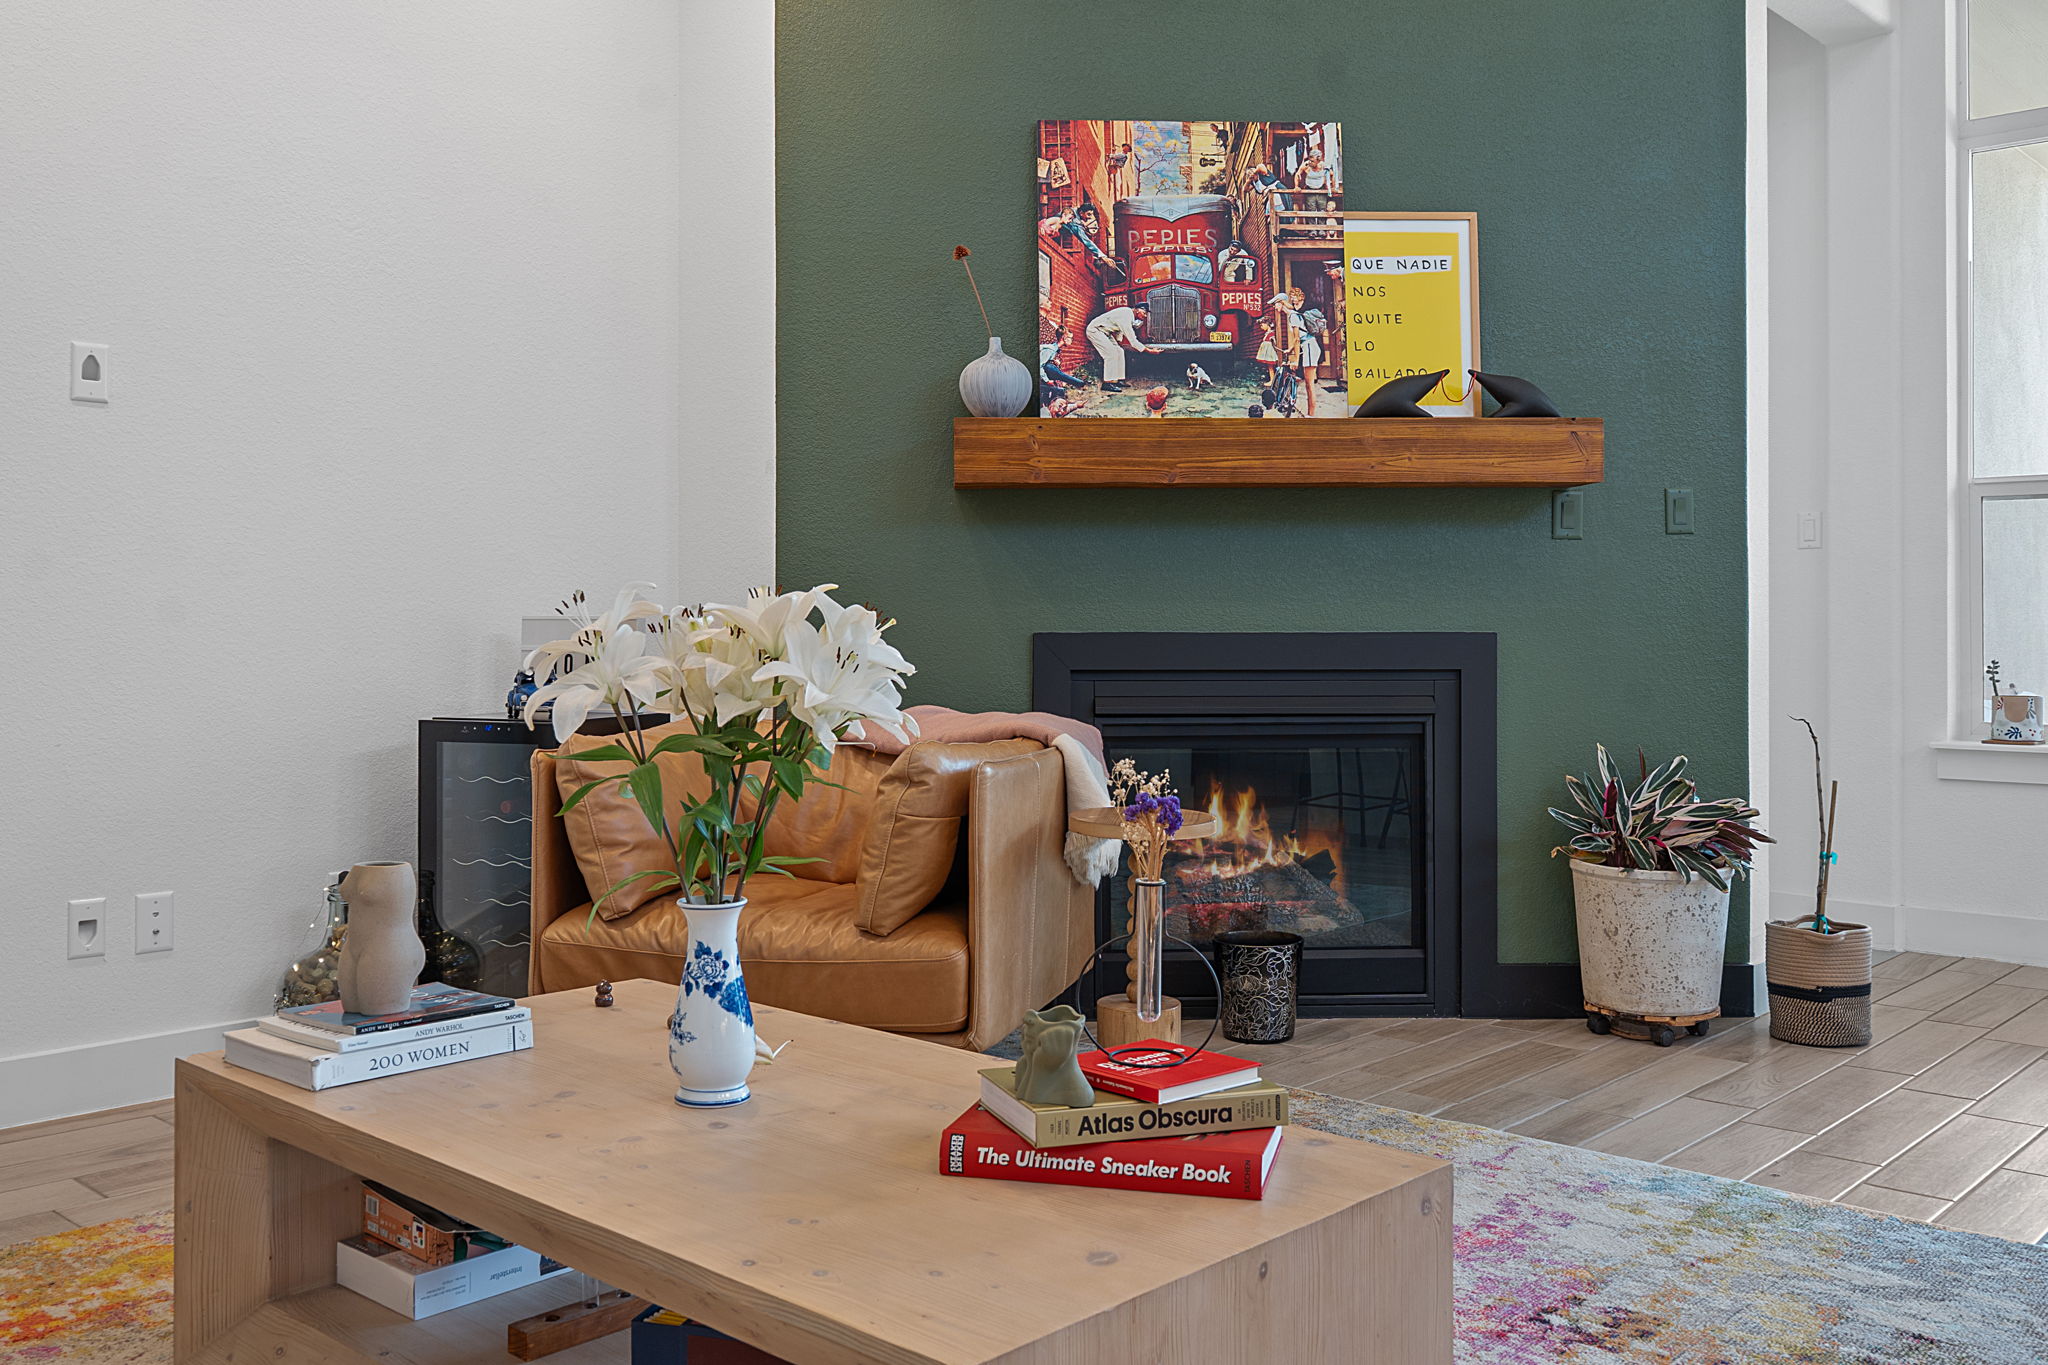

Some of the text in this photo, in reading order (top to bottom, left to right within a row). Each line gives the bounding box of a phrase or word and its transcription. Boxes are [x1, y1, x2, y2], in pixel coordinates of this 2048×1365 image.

[1128, 229, 1217, 249] PEPIES
[1140, 245, 1208, 253] PEPIES
[1352, 258, 1449, 270] QUE NADIE
[1221, 292, 1262, 305] PEPIES
[1352, 286, 1386, 298] NOS
[1104, 294, 1128, 308] PEPIES
[1353, 313, 1403, 325] QUITE
[1354, 340, 1375, 351] LO
[504, 1012, 526, 1021] TASCHEN
[415, 1023, 465, 1037] ANDY WARHOL
[368, 1053, 403, 1072] 200
[408, 1041, 471, 1063] WOMEN
[1077, 1112, 1135, 1136] Atlas
[1138, 1108, 1233, 1130] Obscura
[977, 1146, 1232, 1184] The Ultimate Sneaker Book
[489, 1265, 523, 1281] Interstellar
